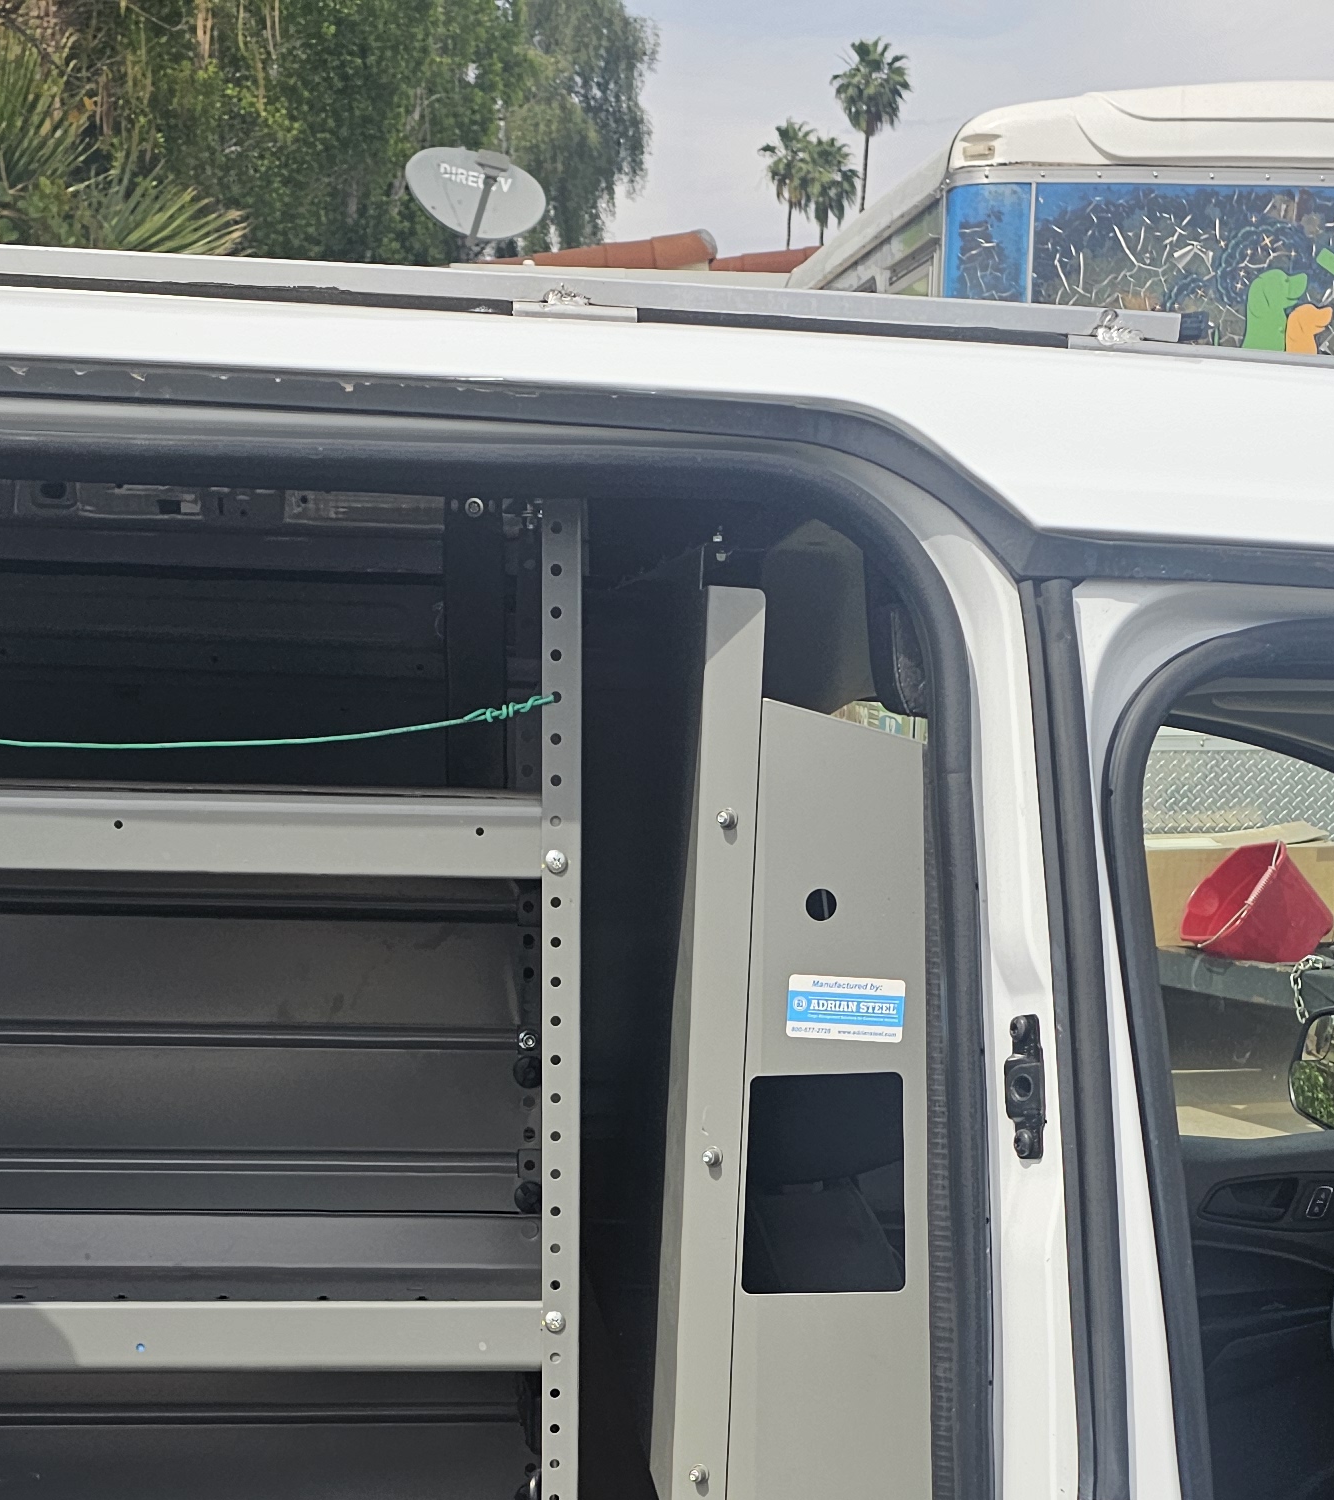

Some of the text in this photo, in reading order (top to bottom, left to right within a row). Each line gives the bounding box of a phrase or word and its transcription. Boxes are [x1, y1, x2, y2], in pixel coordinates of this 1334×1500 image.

[811, 980, 883, 992] Manufactured by:
[809, 999, 897, 1014] ADRIAN STEEL
